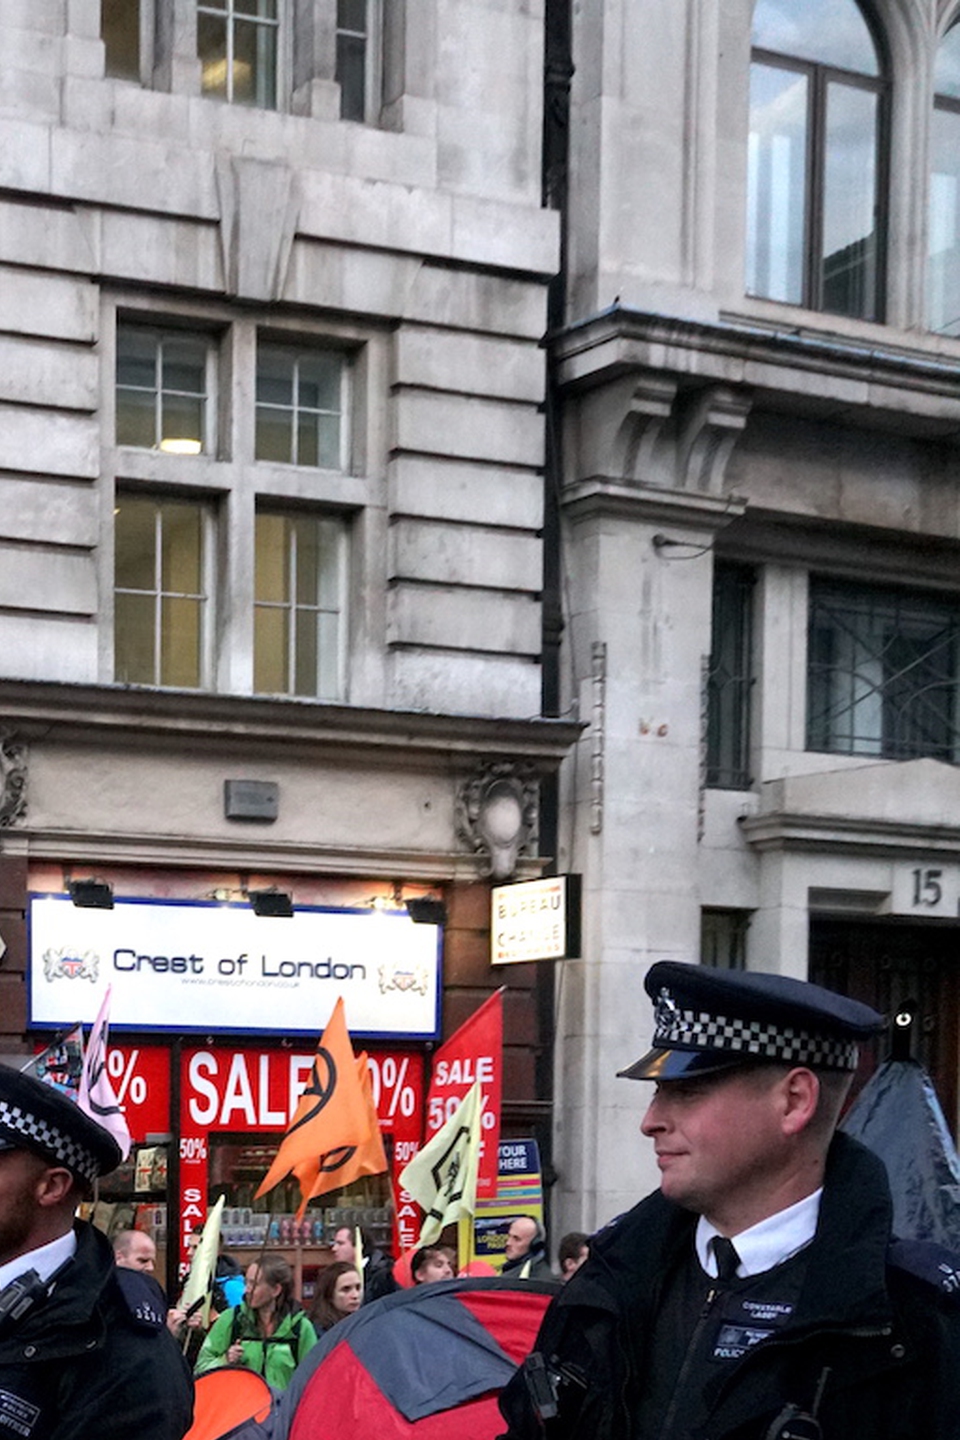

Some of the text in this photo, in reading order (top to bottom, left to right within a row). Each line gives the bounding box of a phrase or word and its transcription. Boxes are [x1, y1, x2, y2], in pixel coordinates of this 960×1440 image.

[911, 868, 943, 908] 15
[497, 923, 559, 948] CHAE
[113, 948, 366, 980] Crest of London
[434, 1056, 494, 1086] SALE
[179, 1138, 207, 1159] 50%
[398, 1190, 417, 1247] SALE
